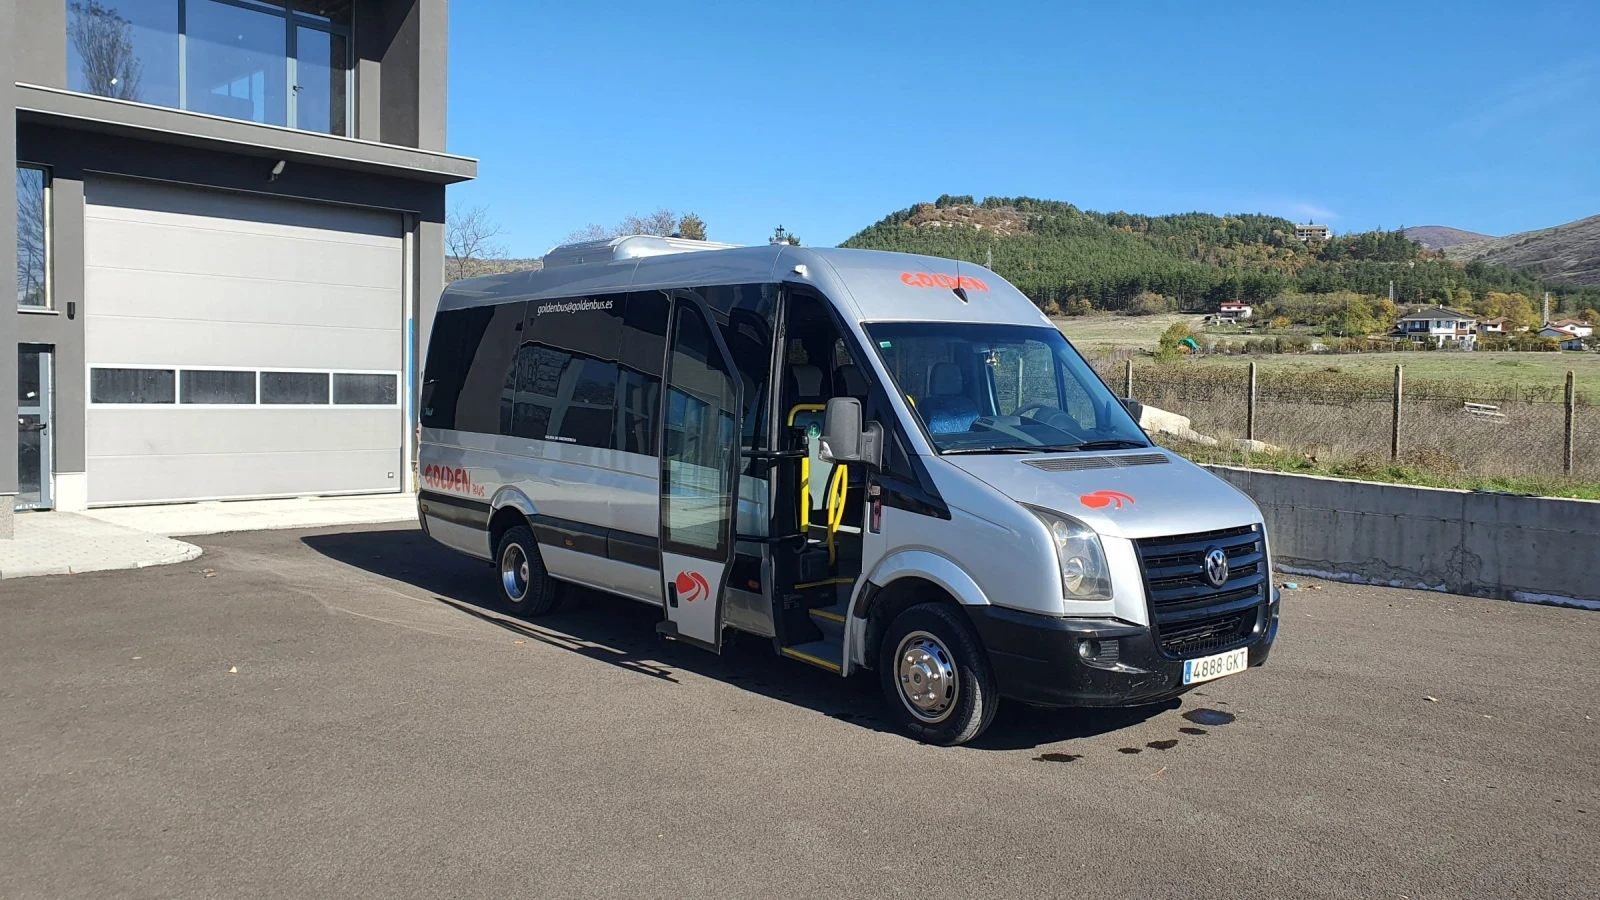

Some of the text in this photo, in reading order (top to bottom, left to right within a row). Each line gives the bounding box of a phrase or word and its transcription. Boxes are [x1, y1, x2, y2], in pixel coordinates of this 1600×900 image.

[900, 271, 989, 292] GOLDEN
[537, 299, 613, 316] goldenbus@goldenbus.es
[424, 464, 485, 497] GOLDEN BUS
[1193, 651, 1246, 679] 4888 GKT
